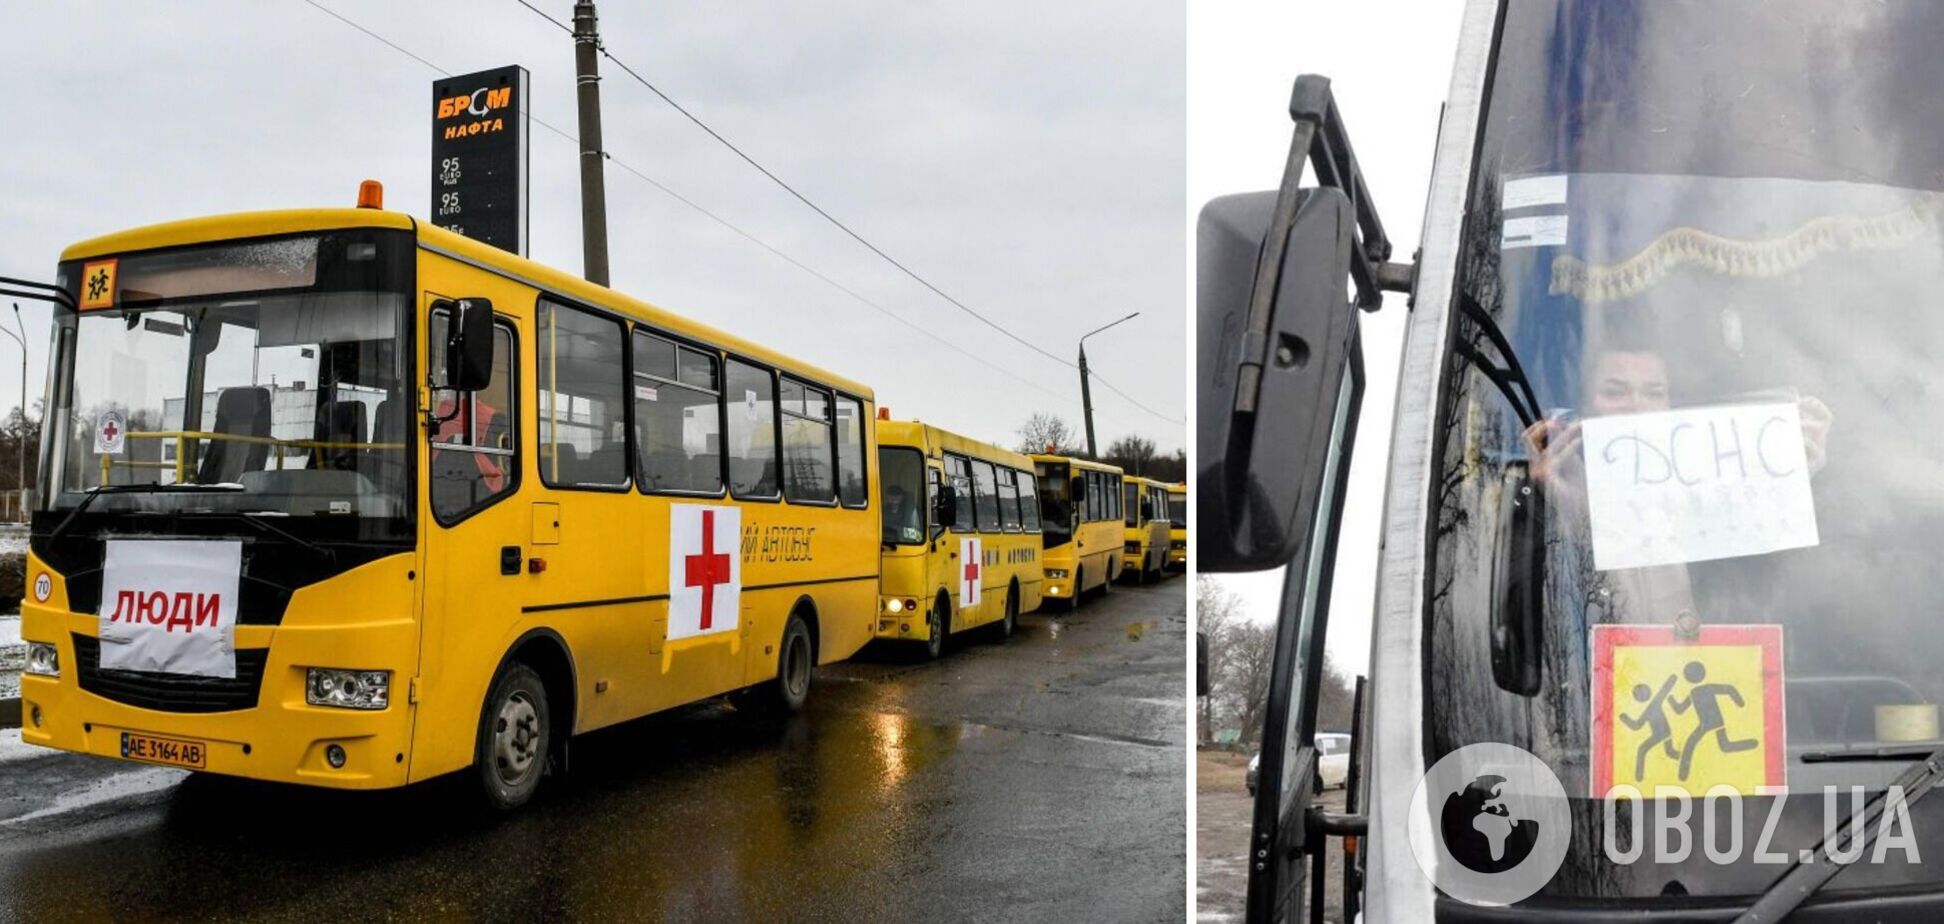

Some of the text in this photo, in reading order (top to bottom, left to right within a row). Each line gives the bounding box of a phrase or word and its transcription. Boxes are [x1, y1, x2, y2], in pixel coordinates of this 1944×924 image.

[444, 118, 503, 140] НАФТА
[442, 157, 460, 173] 95
[441, 192, 459, 208] 95
[1602, 416, 1796, 486] ДСНС
[761, 526, 815, 562] АВТОБУС
[38, 580, 49, 595] 70
[111, 590, 220, 633] ЛЮДИ
[150, 740, 178, 761] 3164
